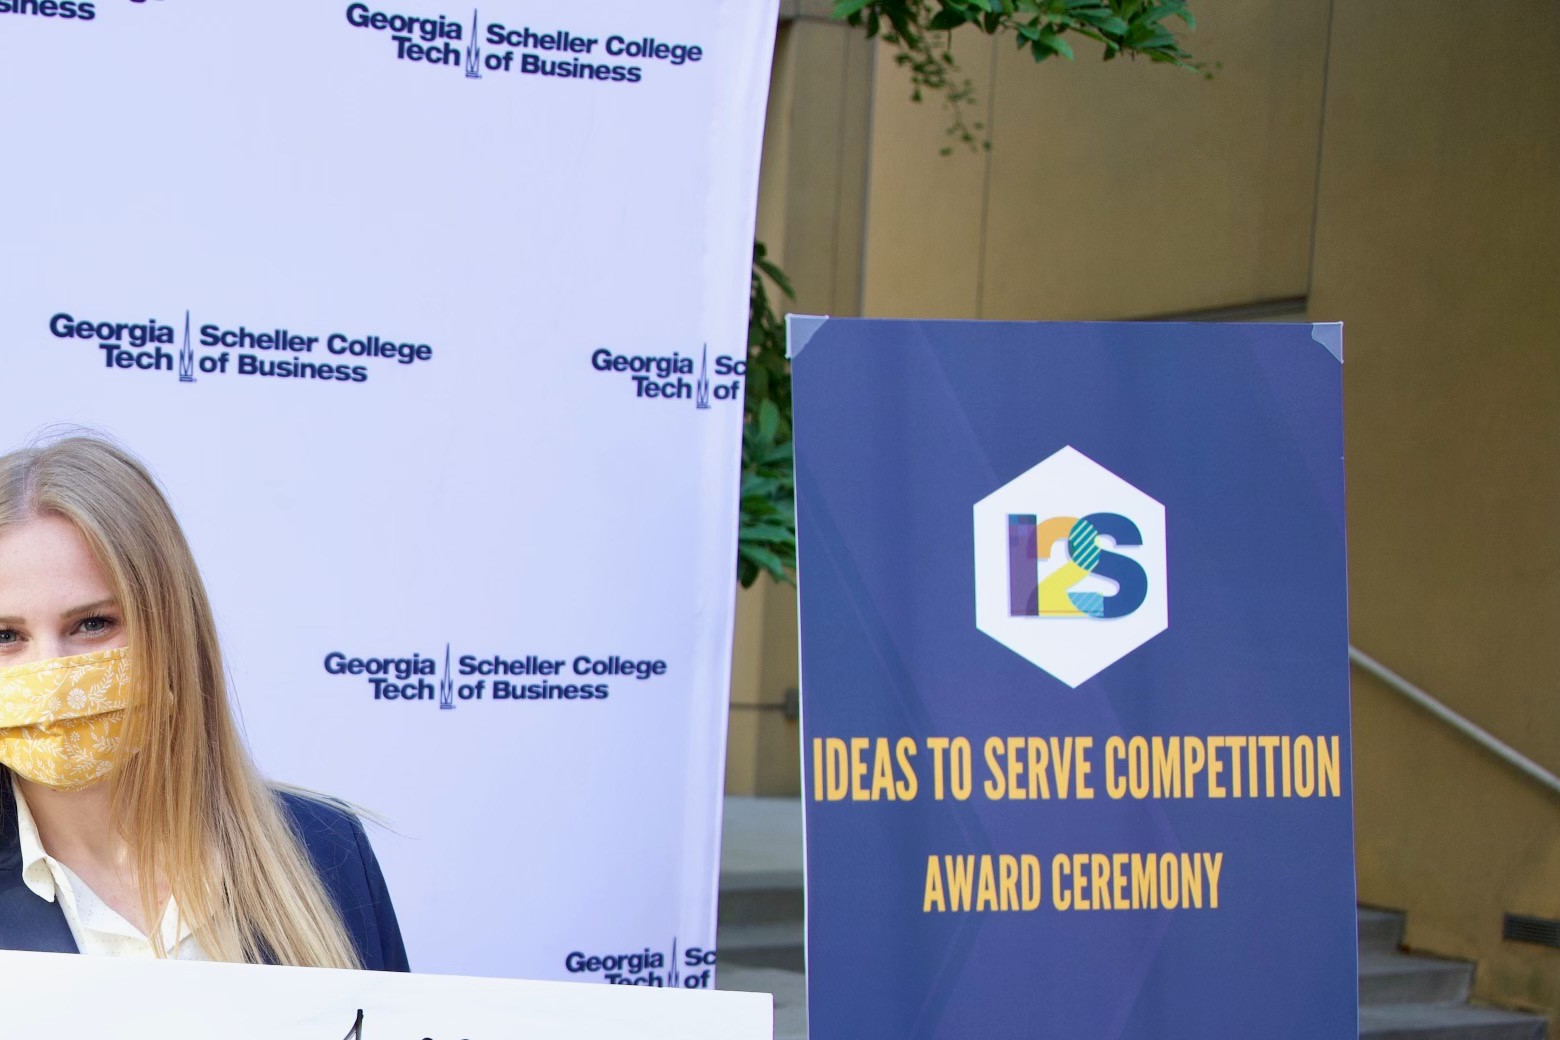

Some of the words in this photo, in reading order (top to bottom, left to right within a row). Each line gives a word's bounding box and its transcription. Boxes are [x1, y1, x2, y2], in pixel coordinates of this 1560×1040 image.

[345, 3, 462, 41] Georgia
[391, 36, 461, 67] Tech
[485, 23, 598, 54] Scheller
[606, 36, 703, 64] College
[484, 51, 513, 72] of
[520, 53, 642, 83] Business
[49, 313, 175, 347] Georgia
[199, 324, 318, 354] Scheller
[326, 333, 433, 364] College
[99, 343, 174, 372] Tech
[198, 353, 229, 375] of
[237, 355, 368, 383] Business
[591, 348, 694, 379] Georgia
[631, 374, 693, 399] Tech
[712, 380, 741, 400] of
[323, 652, 436, 682] Georgia
[457, 655, 565, 676] Scheller
[572, 656, 667, 681] College
[368, 678, 435, 701] Tech
[457, 682, 486, 700] of
[492, 681, 609, 701] Business
[813, 737, 918, 802] IDEAS
[927, 737, 972, 801] TO
[983, 736, 1094, 800] SERVE
[1104, 735, 1342, 799] COMPETITION
[922, 854, 1041, 913] AWARD
[1051, 852, 1224, 911] CEREMONY
[565, 948, 664, 975] Georgia
